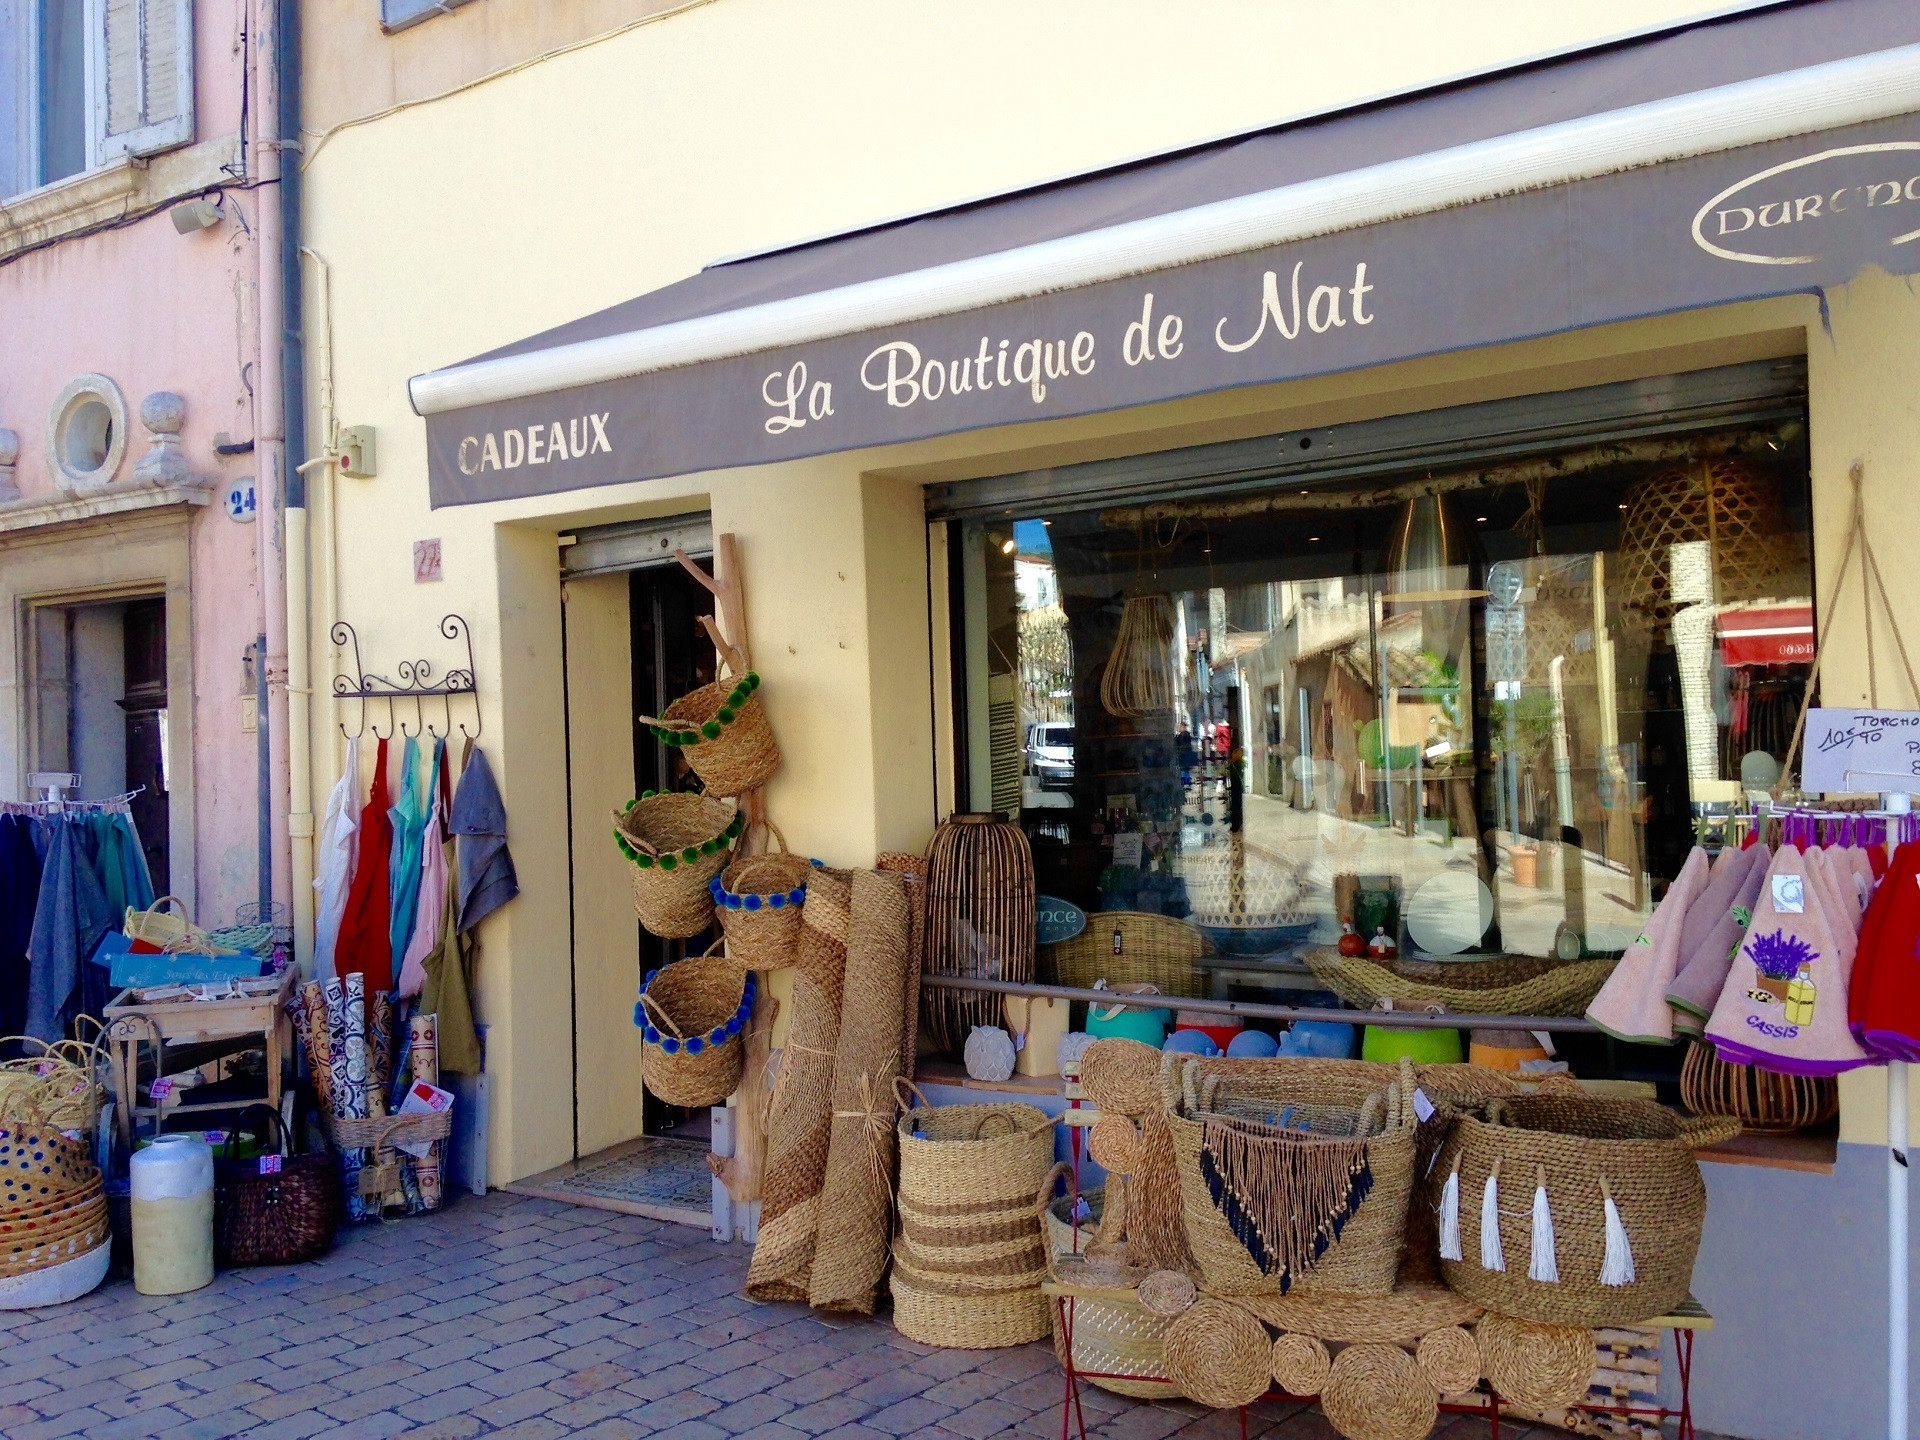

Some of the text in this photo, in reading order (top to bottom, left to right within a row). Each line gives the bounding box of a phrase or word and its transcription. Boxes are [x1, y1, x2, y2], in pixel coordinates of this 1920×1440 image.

[762, 261, 1374, 435] La Boutique de Nat
[458, 412, 613, 476] CADEAUX
[231, 487, 257, 514] 24
[1746, 1015, 1799, 1038] CASSIS
